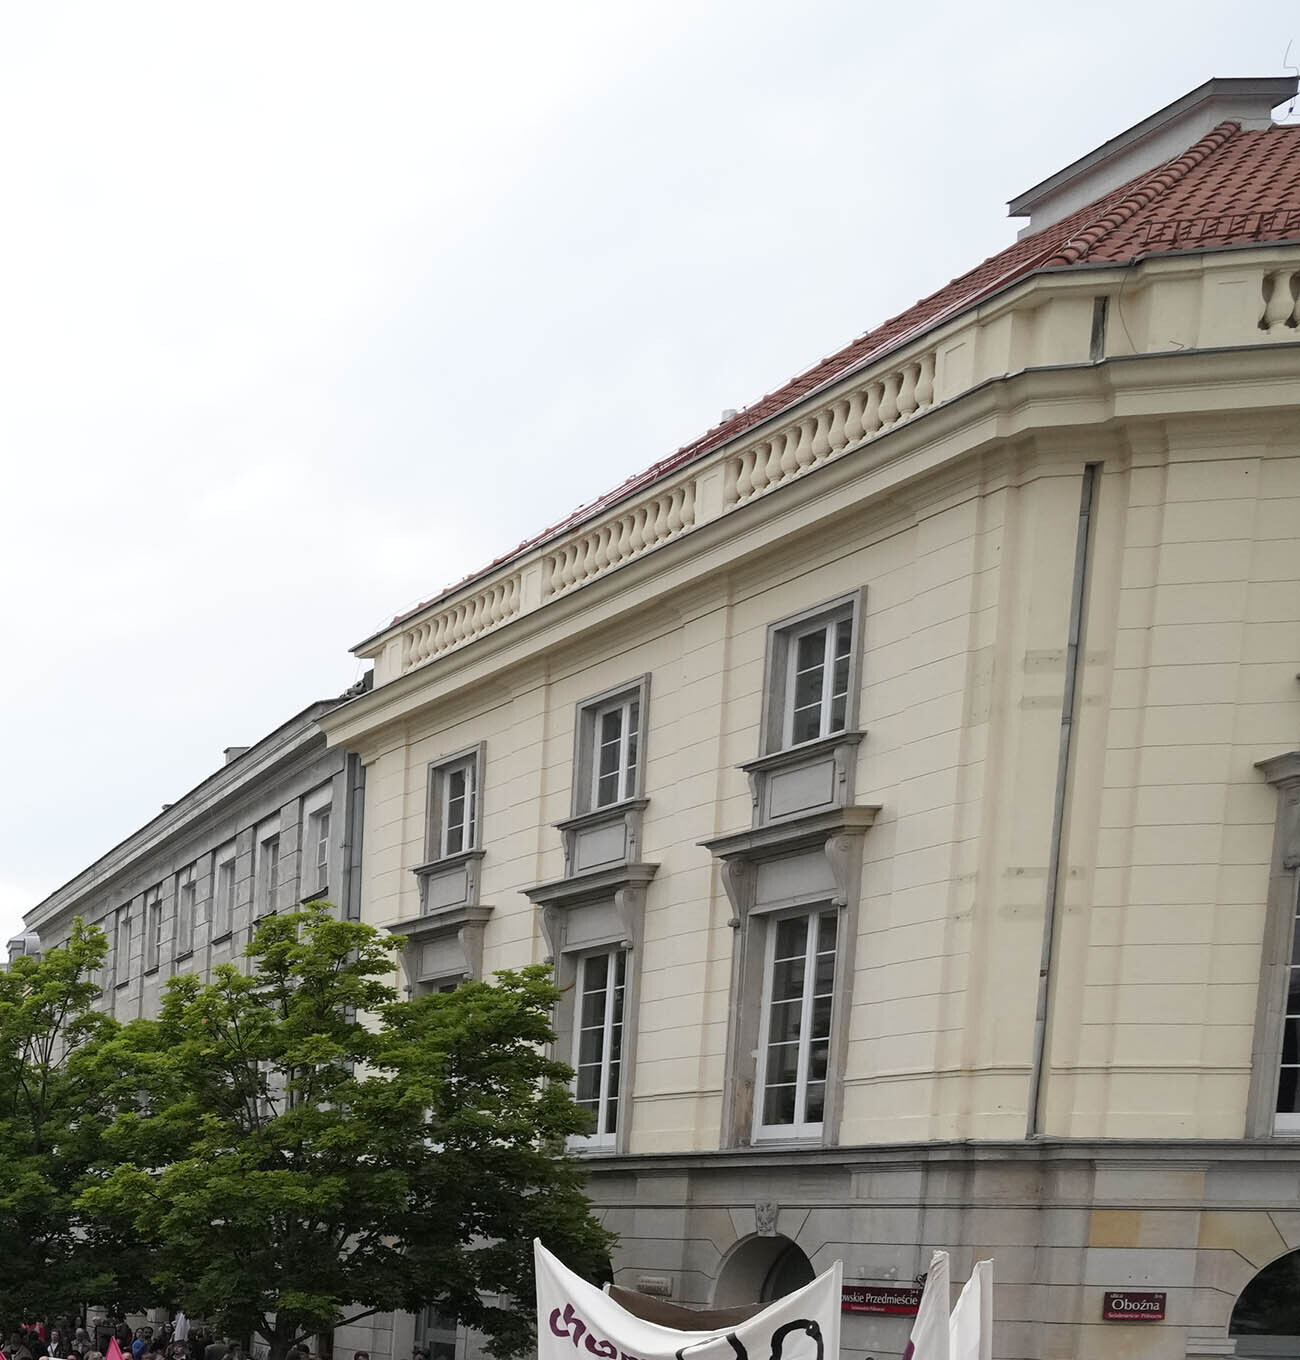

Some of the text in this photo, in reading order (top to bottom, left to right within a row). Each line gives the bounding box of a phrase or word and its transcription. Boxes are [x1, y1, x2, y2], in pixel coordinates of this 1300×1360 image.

[842, 1293, 918, 1306] owskie Przedmieście
[1112, 1298, 1160, 1310] Oboźna
